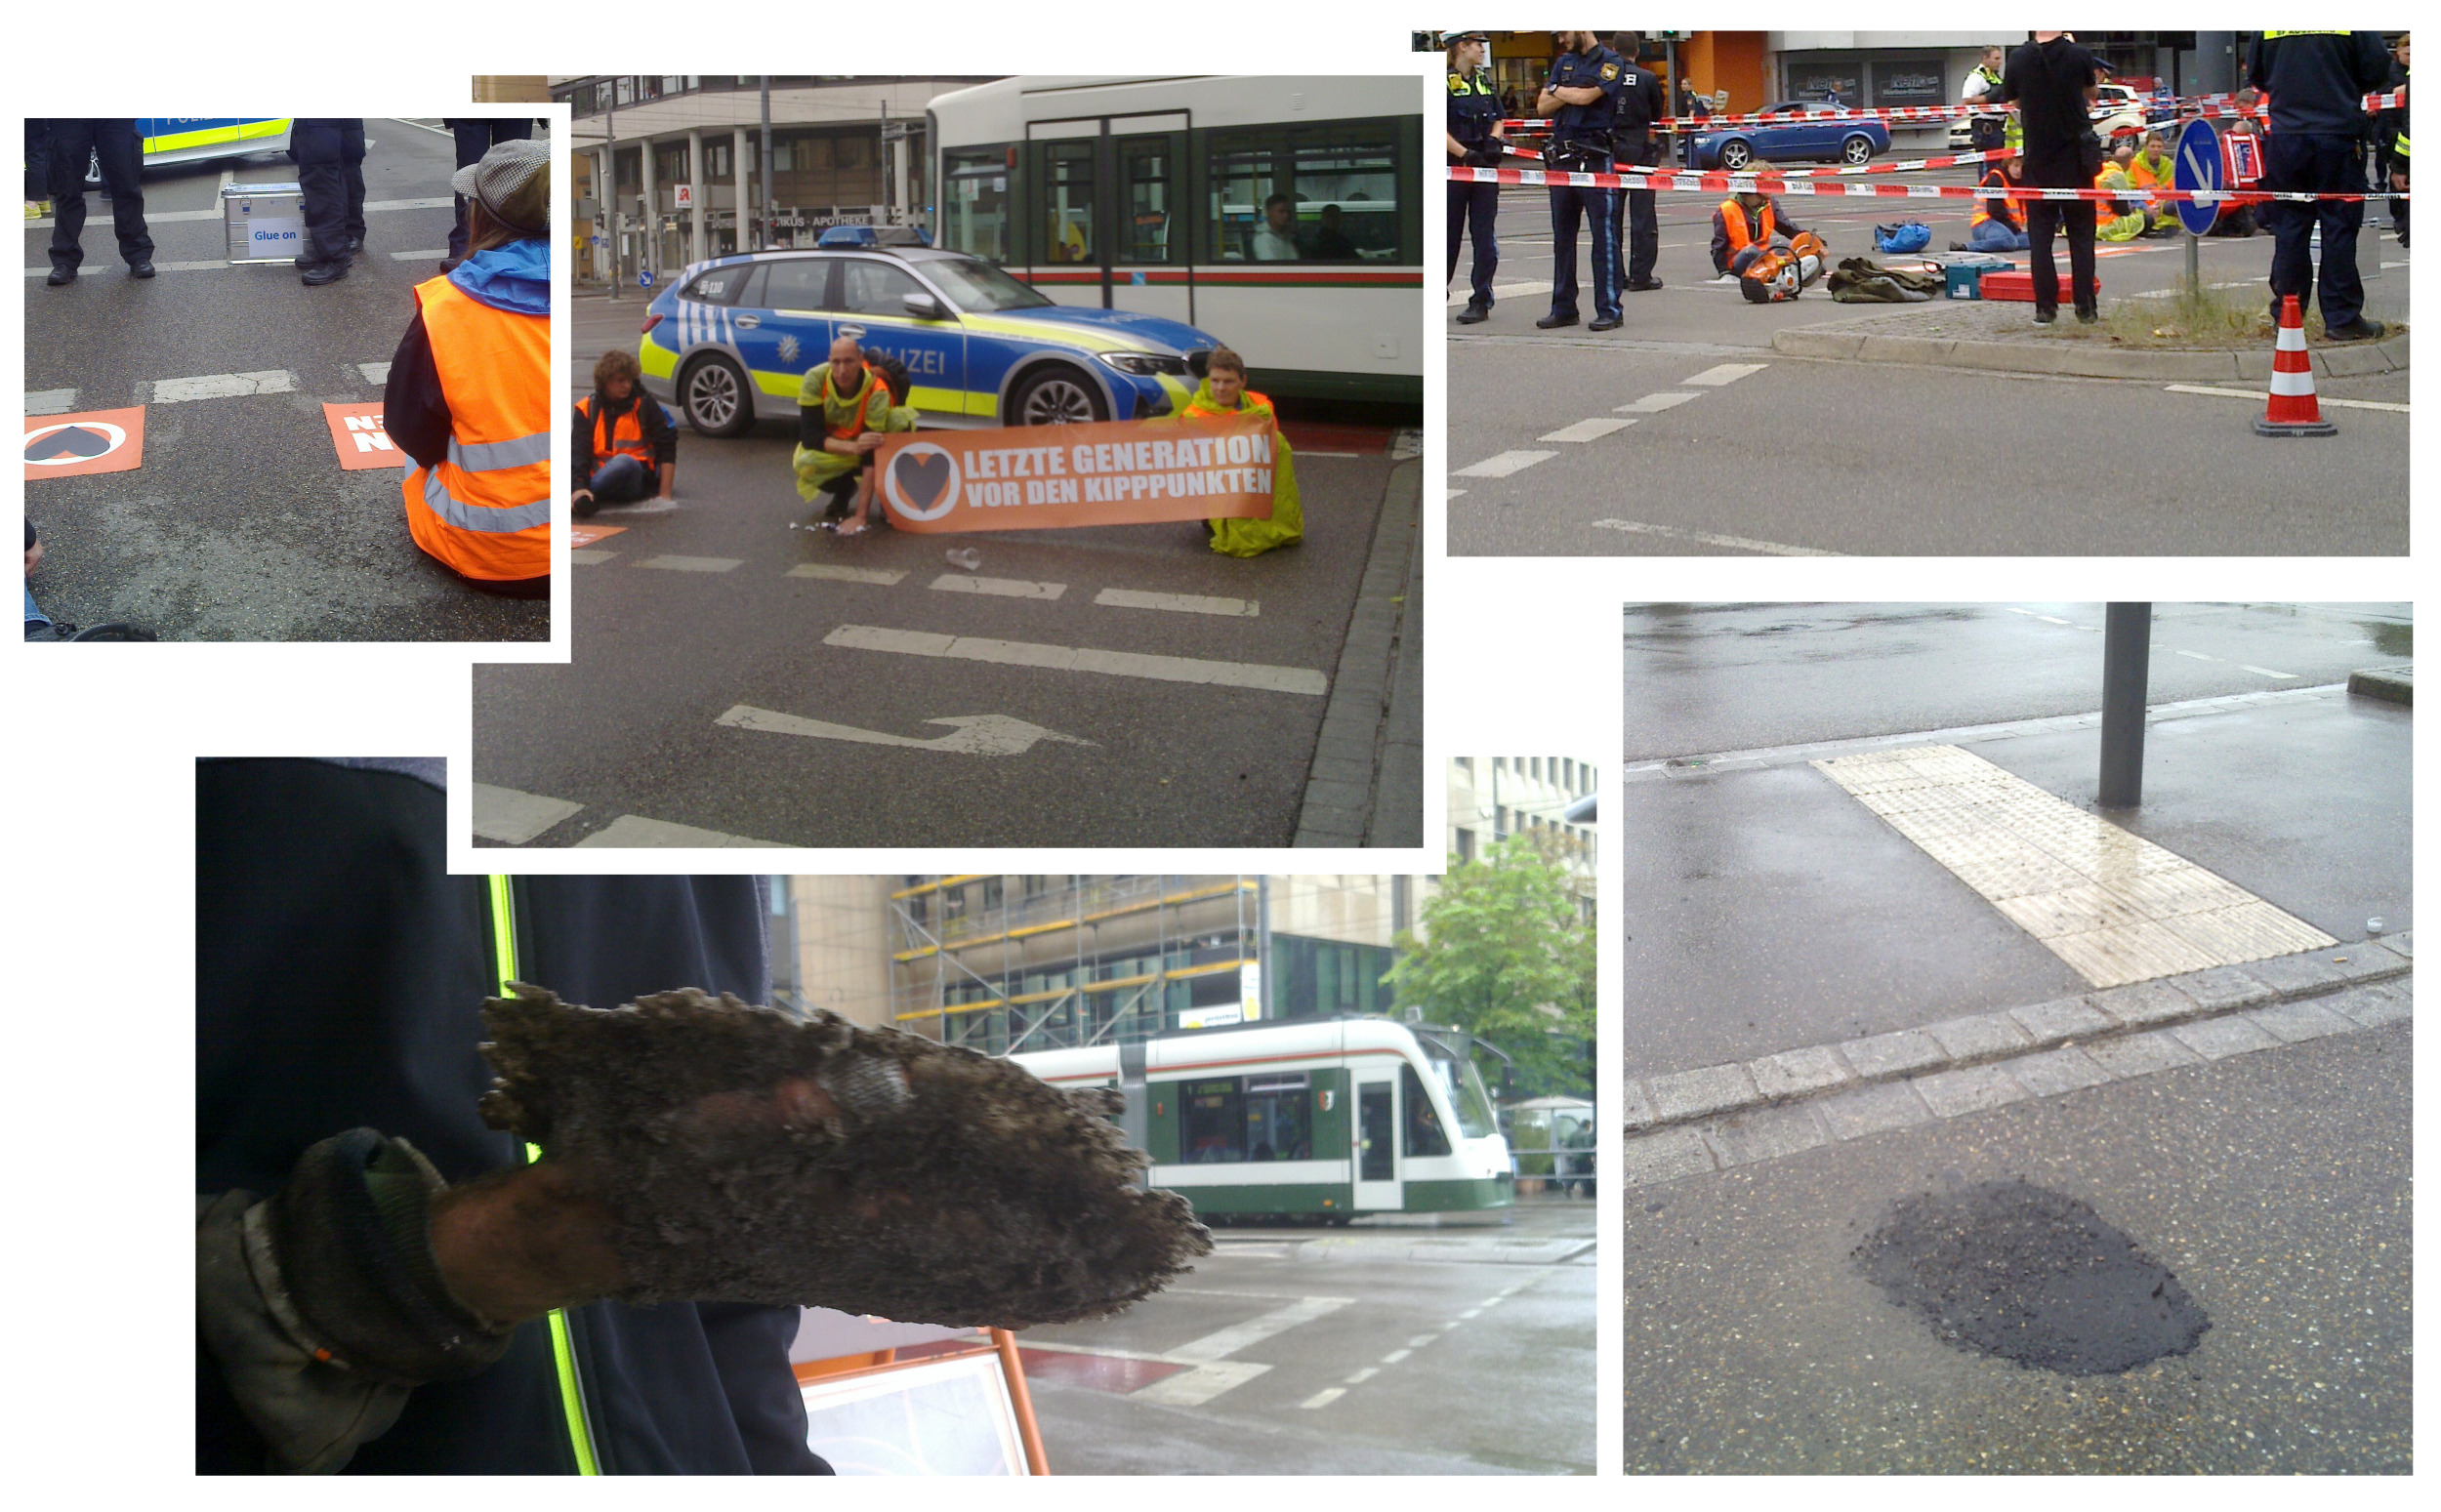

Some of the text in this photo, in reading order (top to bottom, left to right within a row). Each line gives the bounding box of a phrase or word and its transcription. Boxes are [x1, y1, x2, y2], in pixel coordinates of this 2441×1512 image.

[812, 215, 868, 226] APOTHEKE
[254, 230, 297, 241] Glue on
[708, 281, 724, 294] 110
[965, 434, 1270, 479] LETZTE GENERATION
[966, 469, 1271, 508] VOR DEN KIPPPUNKTEN
